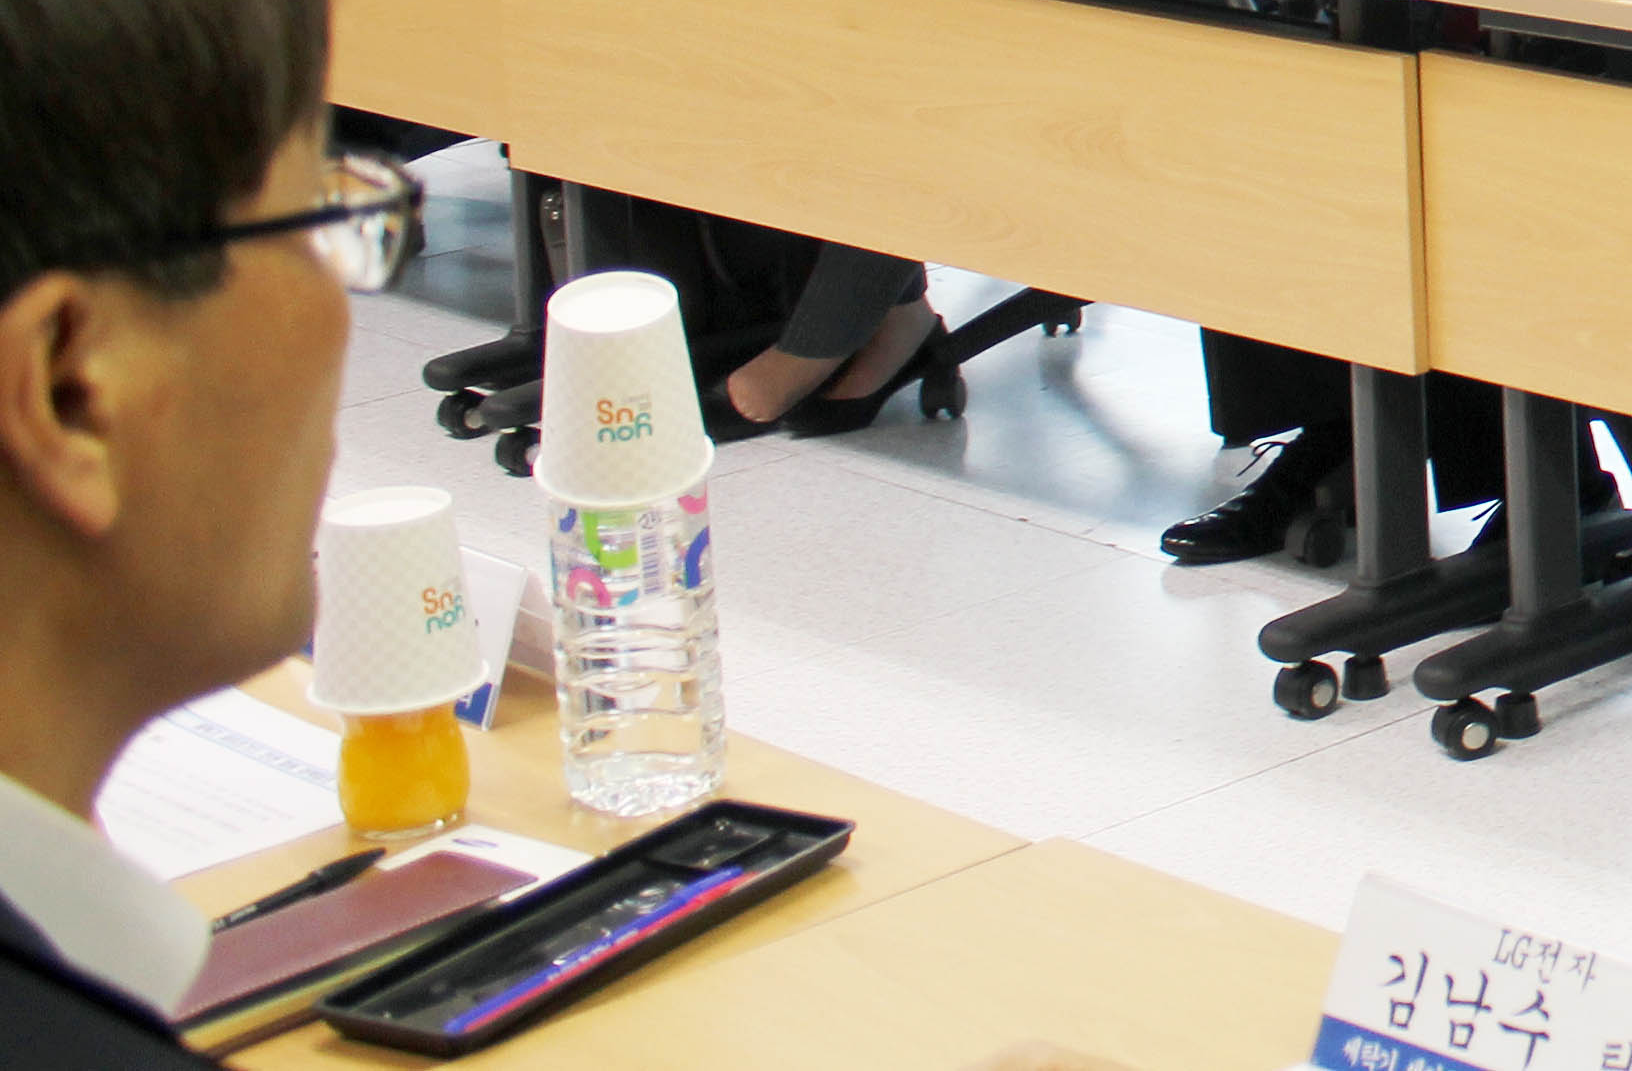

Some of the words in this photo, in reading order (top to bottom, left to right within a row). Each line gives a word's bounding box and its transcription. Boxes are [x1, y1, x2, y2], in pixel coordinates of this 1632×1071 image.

[597, 400, 633, 425] us
[597, 412, 653, 444] you
[422, 587, 455, 615] us
[426, 596, 465, 635] you
[1493, 928, 1600, 993] LG전자
[1380, 948, 1552, 1070] 김남수
